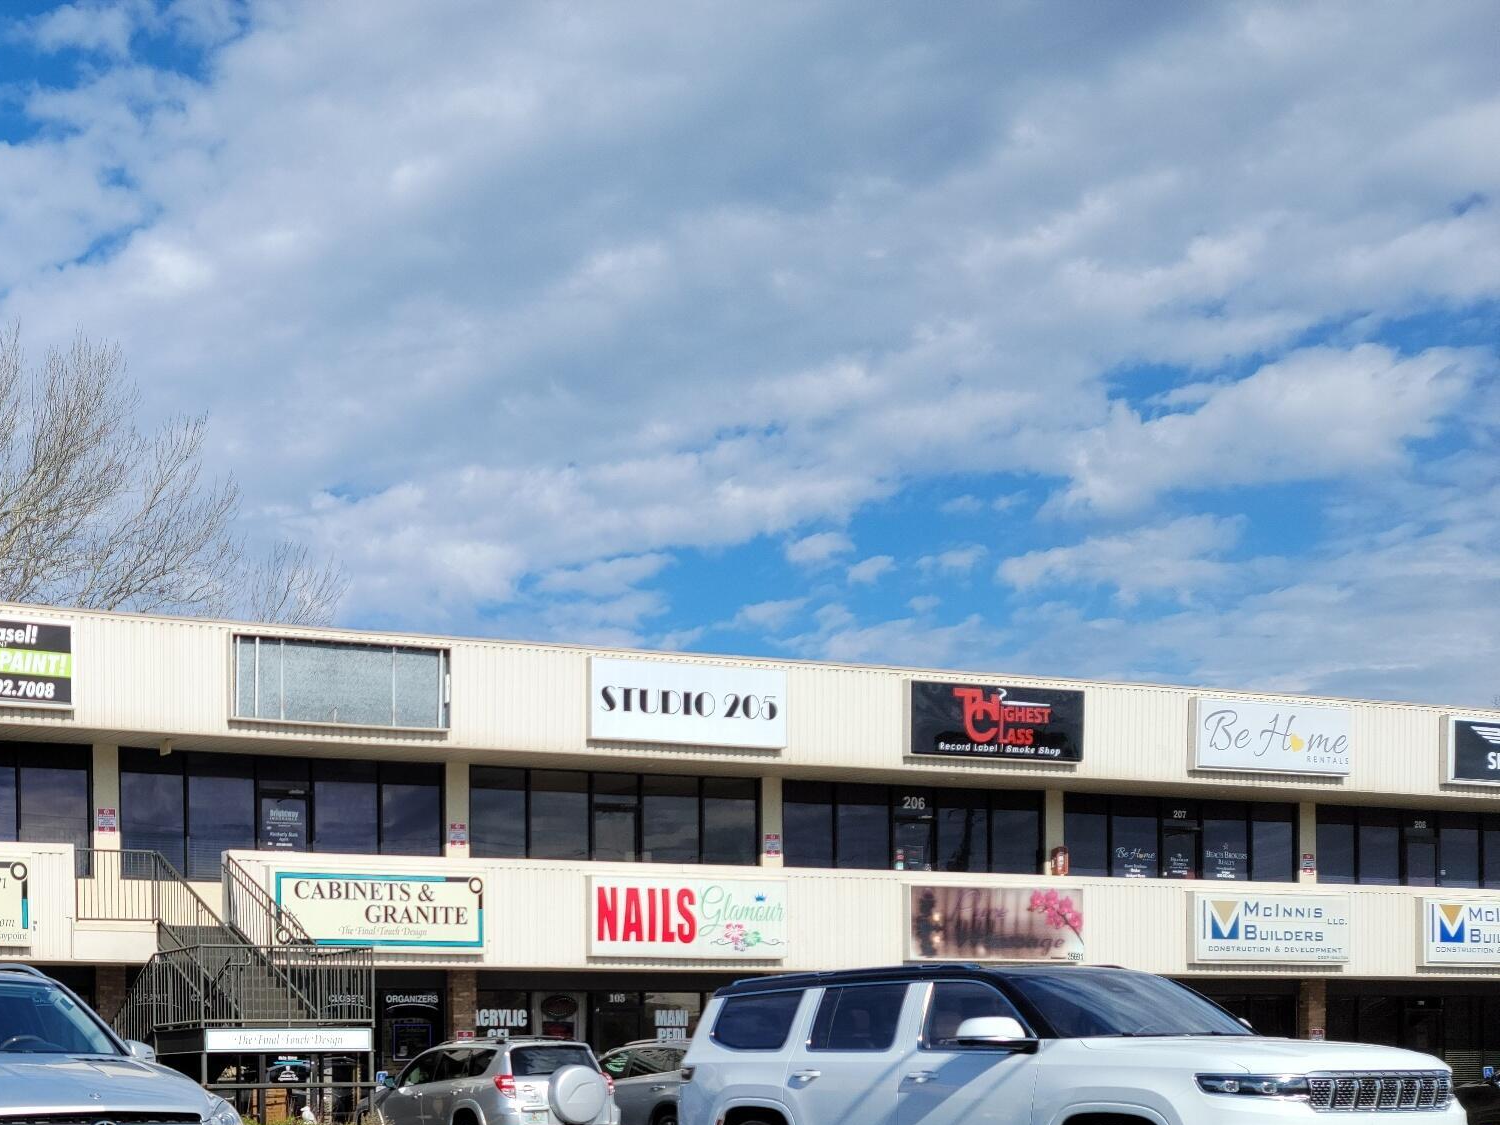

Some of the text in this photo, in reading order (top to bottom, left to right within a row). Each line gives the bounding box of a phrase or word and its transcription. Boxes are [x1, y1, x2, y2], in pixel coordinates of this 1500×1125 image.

[600, 685, 778, 721] STUDIO 205
[1204, 709, 1252, 751] Be
[939, 741, 1061, 757] Record Label Smoke Shop
[1306, 755, 1349, 765] RENTALS
[903, 796, 926, 810] 206
[1172, 809, 1187, 819] 207
[293, 880, 436, 903] CABINETS &
[364, 904, 468, 926] GRANITE
[597, 885, 786, 944] NAILS Glamour
[1326, 918, 1349, 926] LLC.
[338, 925, 354, 936] The
[355, 926, 377, 936] Final
[1244, 924, 1325, 942] BUILDERS
[1208, 945, 1271, 953] CONSTRUCTION
[1284, 946, 1343, 954] DEVELOPMENT
[1435, 946, 1494, 954] CONSTRUCTION
[386, 994, 439, 1004] ORGANIZERS
[609, 993, 626, 1003] 105
[655, 1009, 689, 1027] MANI
